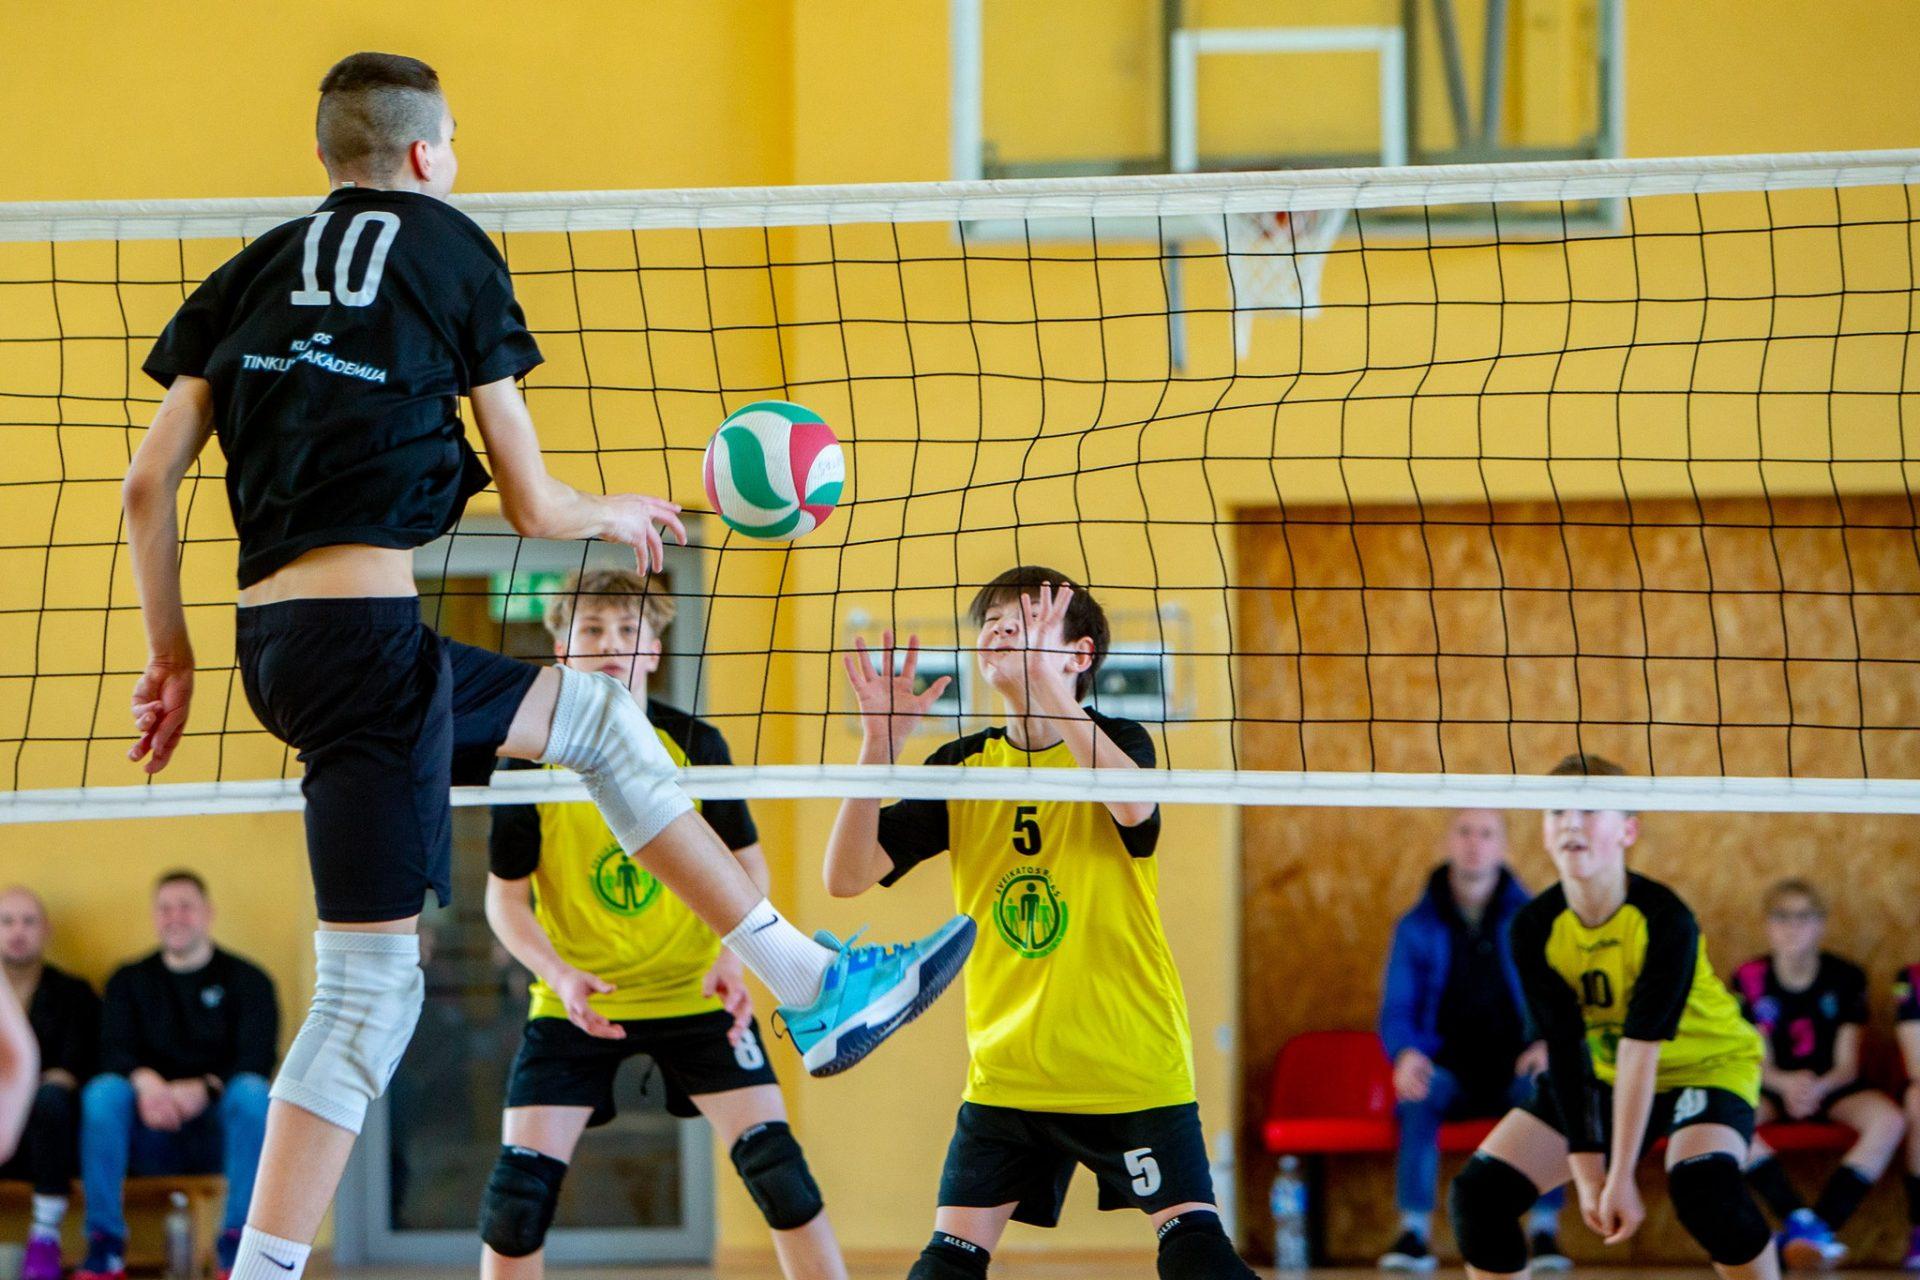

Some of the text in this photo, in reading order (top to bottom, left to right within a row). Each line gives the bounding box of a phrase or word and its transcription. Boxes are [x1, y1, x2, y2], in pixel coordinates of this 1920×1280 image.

[290, 210, 401, 307] 10
[300, 350, 387, 383] AKADEMIJA
[1012, 806, 1042, 856] 5
[734, 1027, 764, 1070] 8
[1123, 1147, 1162, 1197] 5
[943, 1235, 977, 1253] ALLSIX
